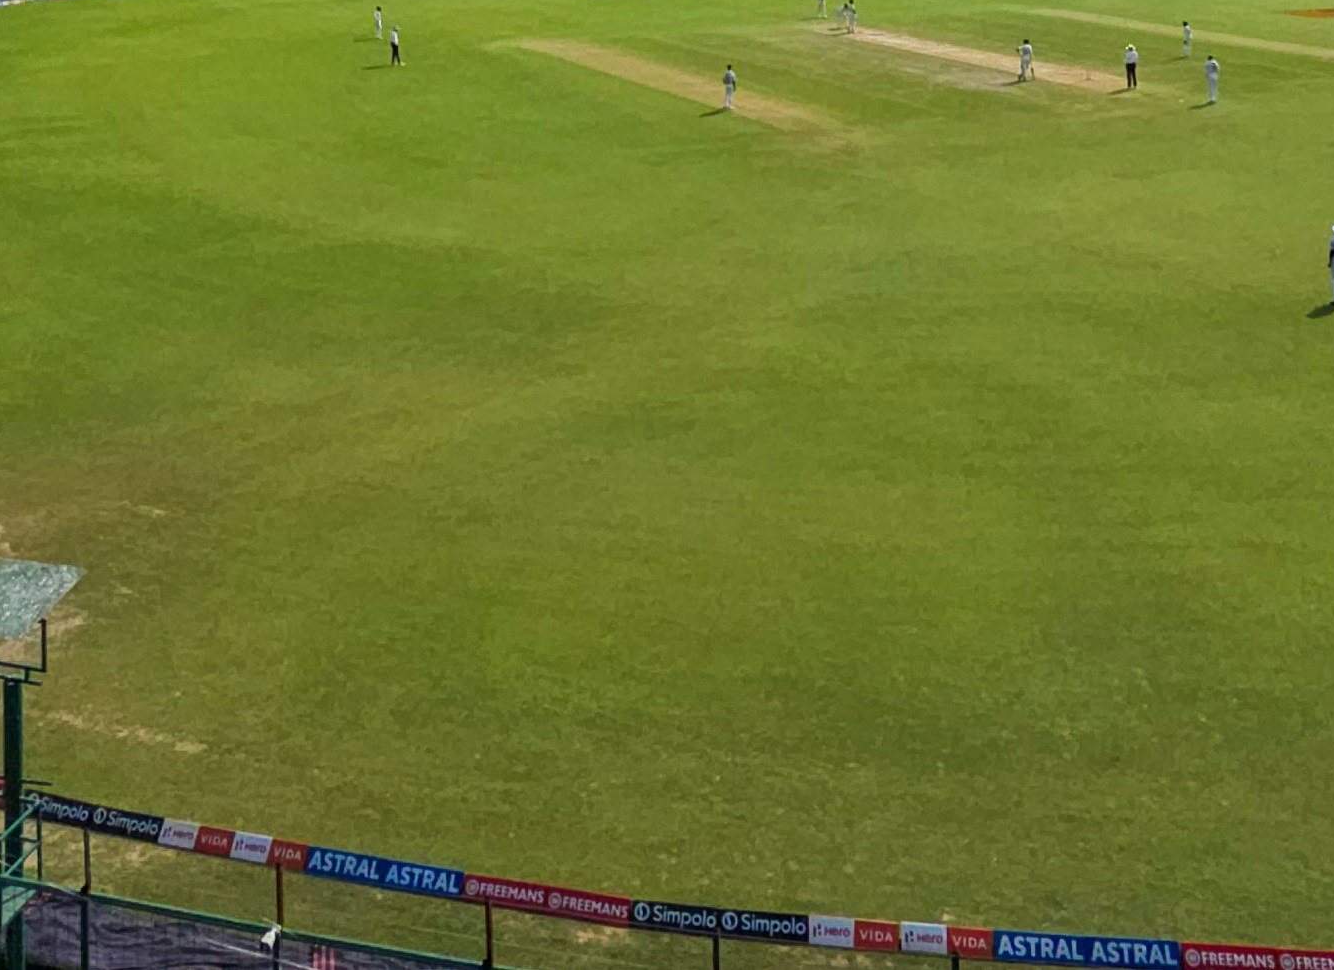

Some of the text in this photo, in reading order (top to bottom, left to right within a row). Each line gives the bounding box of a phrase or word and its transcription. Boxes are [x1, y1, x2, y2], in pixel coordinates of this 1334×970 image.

[40, 796, 159, 837] Simpolo Simpolo
[200, 834, 229, 848] VIDA
[273, 847, 302, 862] VIDA
[308, 850, 461, 895] ASTRAL ASTRAL
[480, 882, 629, 920] FREEMANS FREEMANS
[652, 904, 807, 938] Simpolo Simpolo
[858, 929, 895, 944] VIDA
[951, 935, 988, 951] VIDA
[998, 934, 1179, 968] ASTRAL ASTRAL
[1201, 949, 1276, 970] FREEMANS
